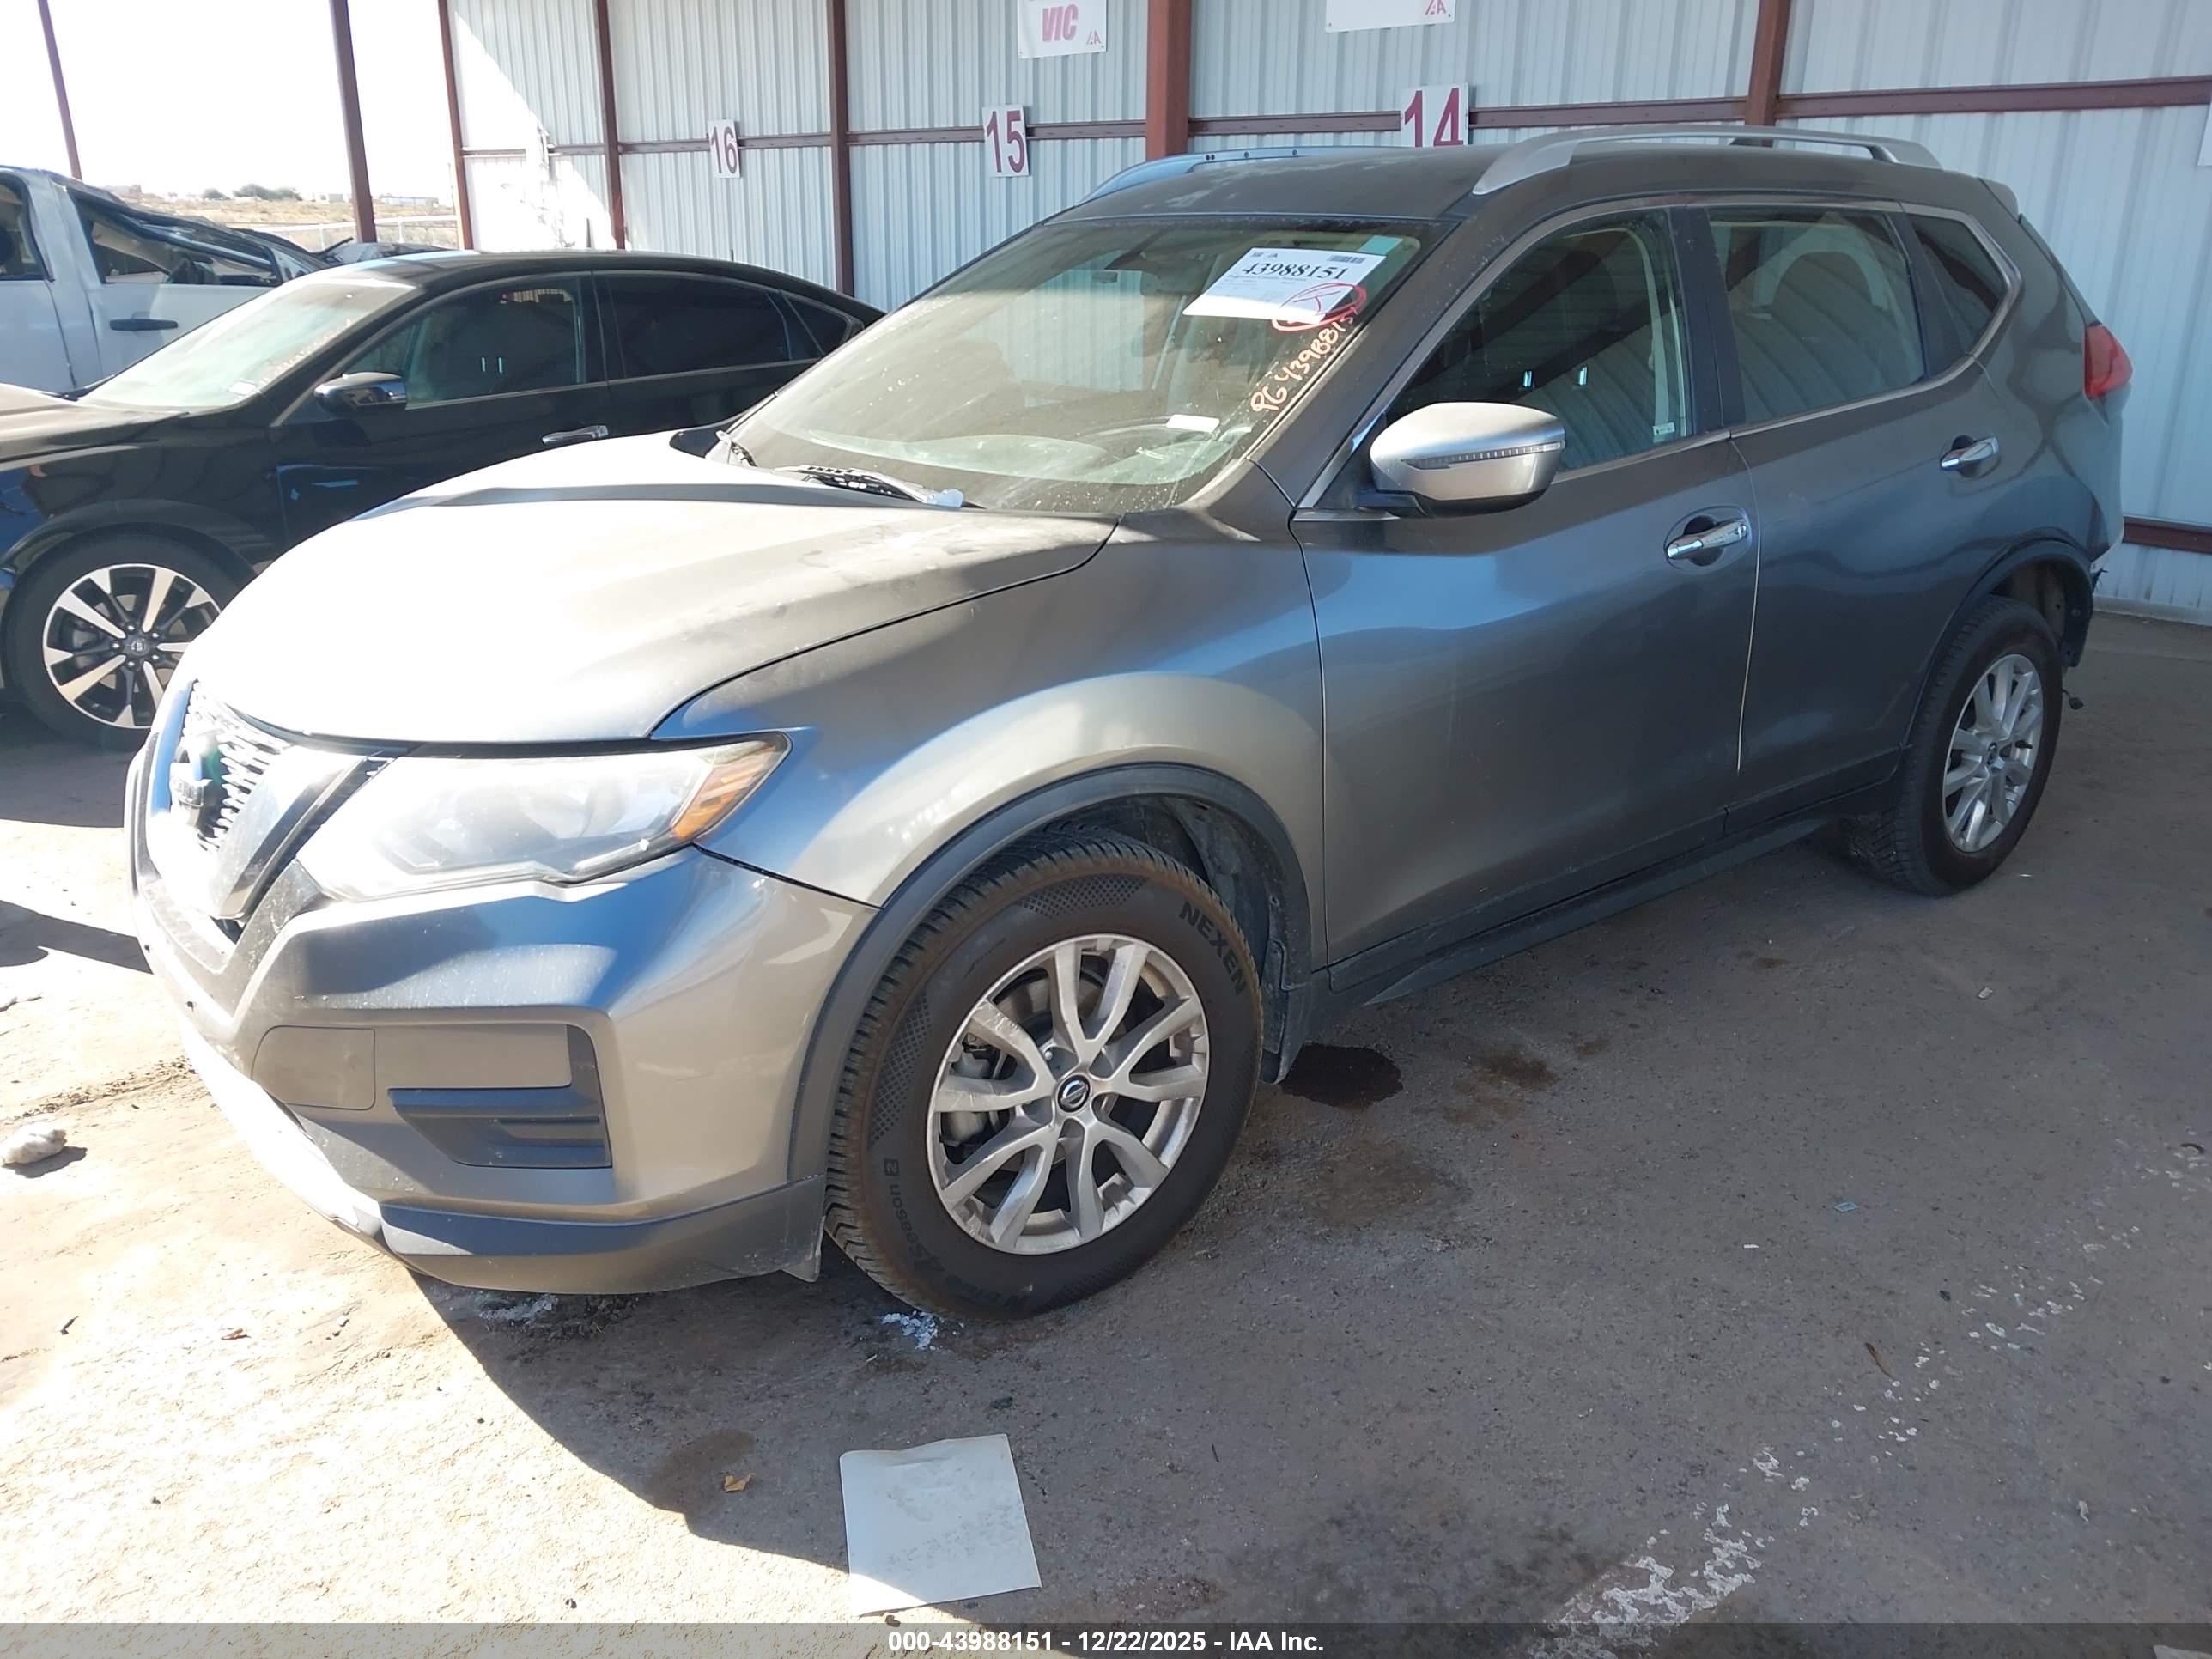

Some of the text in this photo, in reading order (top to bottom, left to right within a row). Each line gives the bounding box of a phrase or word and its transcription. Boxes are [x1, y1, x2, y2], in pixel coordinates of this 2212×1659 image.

[1042, 3, 1079, 42] VIC
[987, 109, 1025, 173] 15
[1405, 88, 1464, 147] 14
[710, 126, 738, 174] 16
[1242, 262, 1348, 280] 43988151
[1179, 901, 1248, 995] NEXEN
